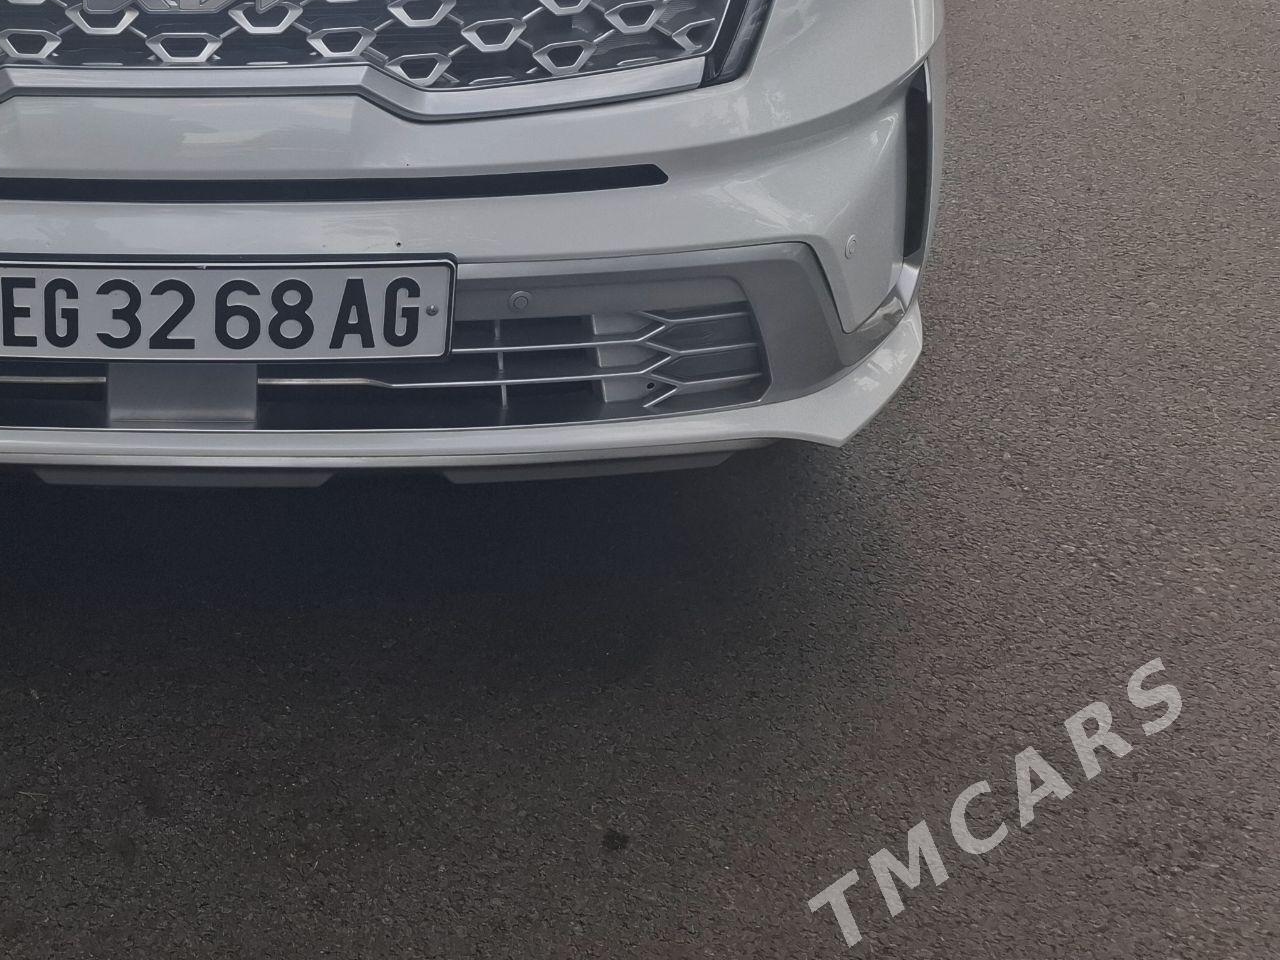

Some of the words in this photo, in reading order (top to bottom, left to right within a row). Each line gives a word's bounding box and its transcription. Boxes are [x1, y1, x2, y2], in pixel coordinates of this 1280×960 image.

[0, 276, 80, 349] EG
[95, 278, 196, 350] 32
[213, 278, 315, 350] 68
[328, 277, 421, 349] AG
